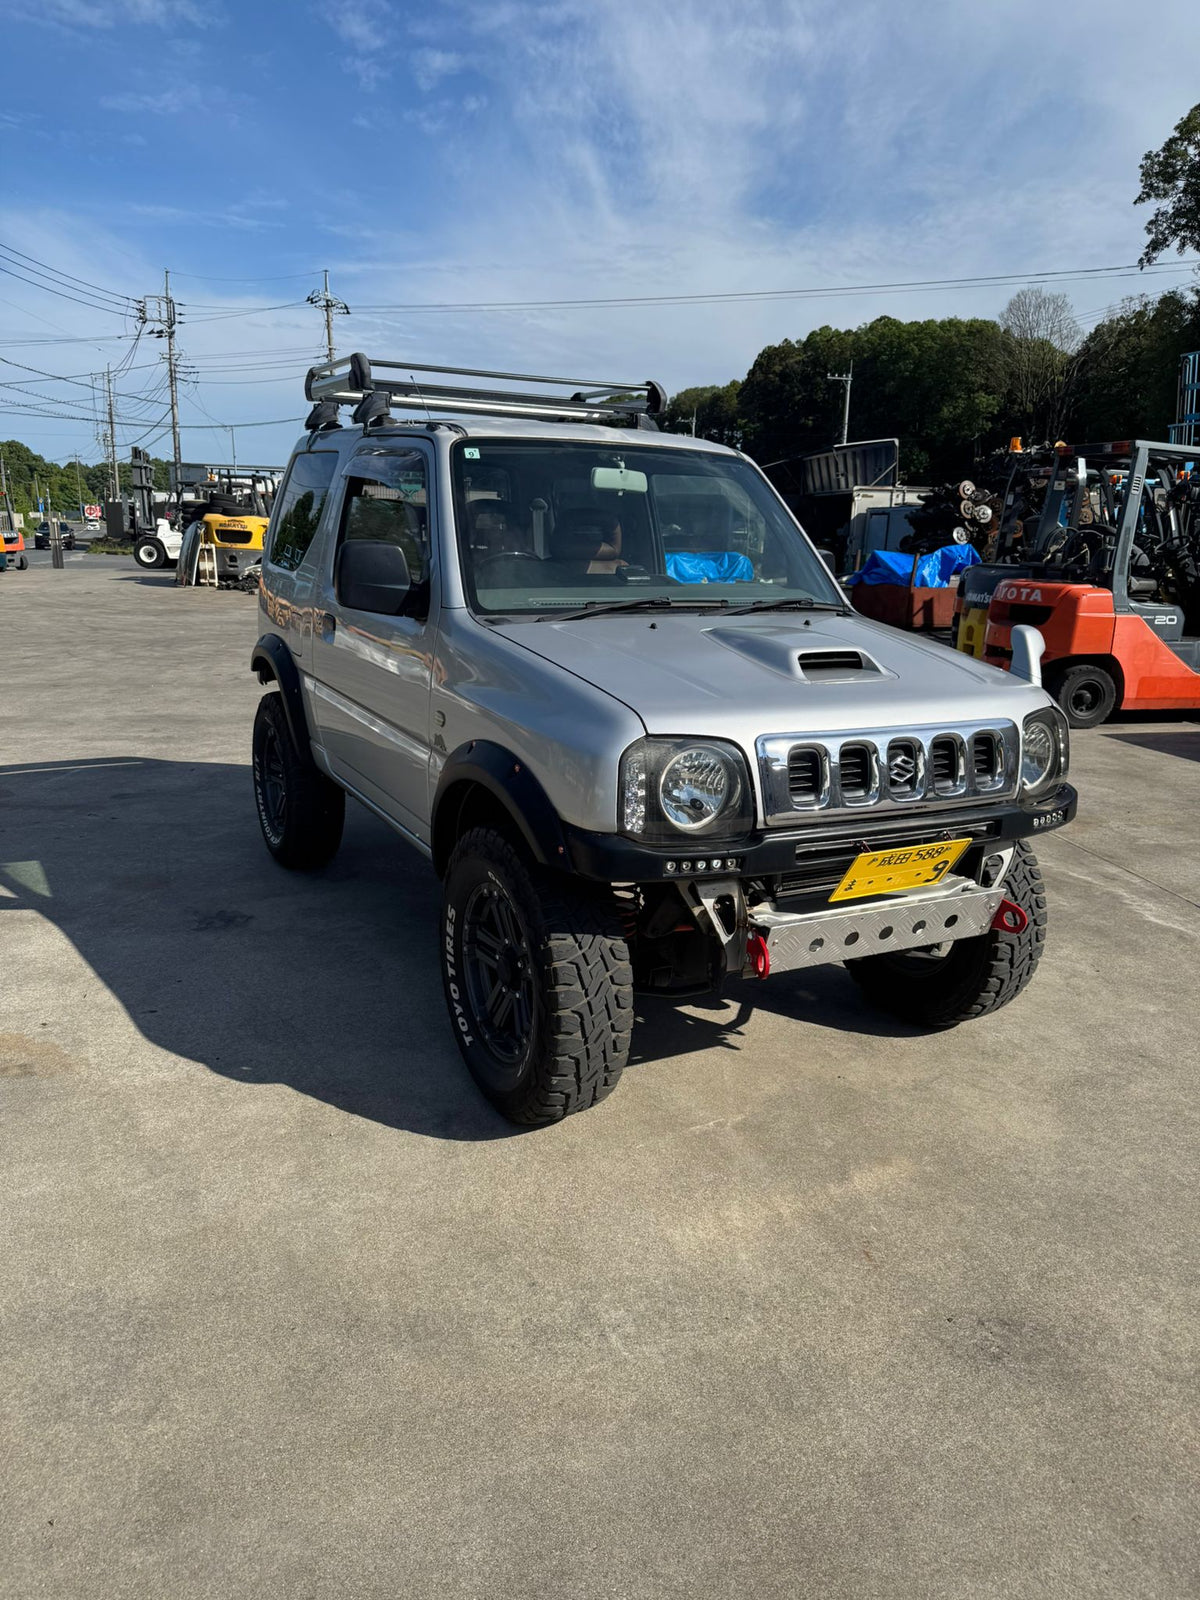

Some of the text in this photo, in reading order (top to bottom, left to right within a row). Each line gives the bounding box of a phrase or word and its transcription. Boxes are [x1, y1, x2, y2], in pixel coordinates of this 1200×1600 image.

[1154, 615, 1178, 625] 20
[877, 847, 945, 867] 成田 588
[445, 903, 474, 1047] TOYO TIRES
